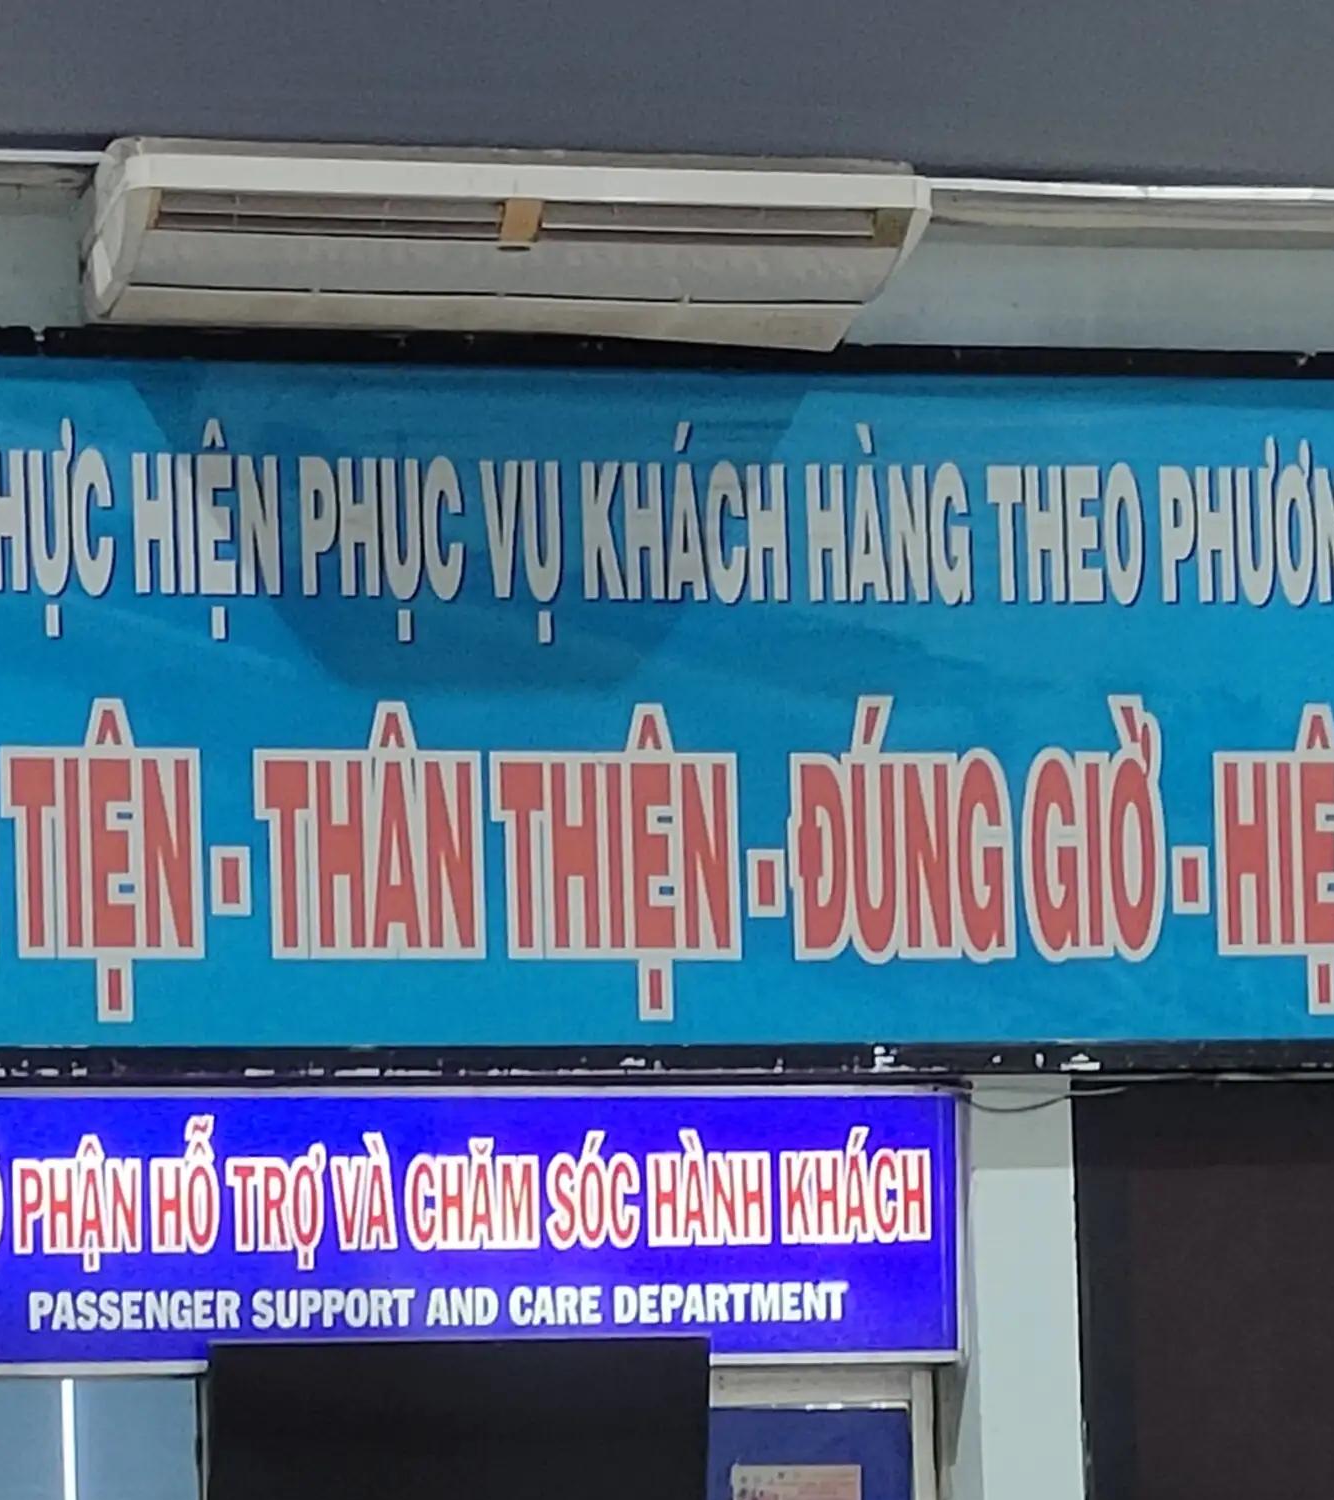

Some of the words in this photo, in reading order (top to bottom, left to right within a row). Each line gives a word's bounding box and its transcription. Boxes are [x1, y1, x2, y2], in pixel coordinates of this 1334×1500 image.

[131, 418, 283, 640] HIỆN
[299, 455, 465, 642] PHỤC
[479, 459, 562, 644] VỤ
[579, 421, 786, 604] KHÁCH
[804, 422, 973, 605] HÀNG
[986, 462, 1145, 605] THEO
[253, 701, 487, 961] THÂN
[490, 703, 743, 1022] THIỆN
[787, 694, 1017, 964] ĐÚNG
[1022, 694, 1165, 962] GIỜ
[12, 1134, 142, 1272] PHẬN
[150, 1114, 220, 1255] HỖ
[225, 1142, 327, 1271] TRỢ
[330, 1131, 398, 1251] VÀ
[404, 1136, 540, 1251] CHĂM
[546, 1130, 640, 1250] SÓC
[647, 1128, 771, 1247] HÀNH
[778, 1126, 932, 1244] KHÁCH
[28, 1290, 240, 1331] PASSENGER
[252, 1288, 415, 1330] SUPPORT
[426, 1286, 498, 1326] AND
[509, 1285, 602, 1326] CARE
[613, 1281, 849, 1325] DEPARTMENT
